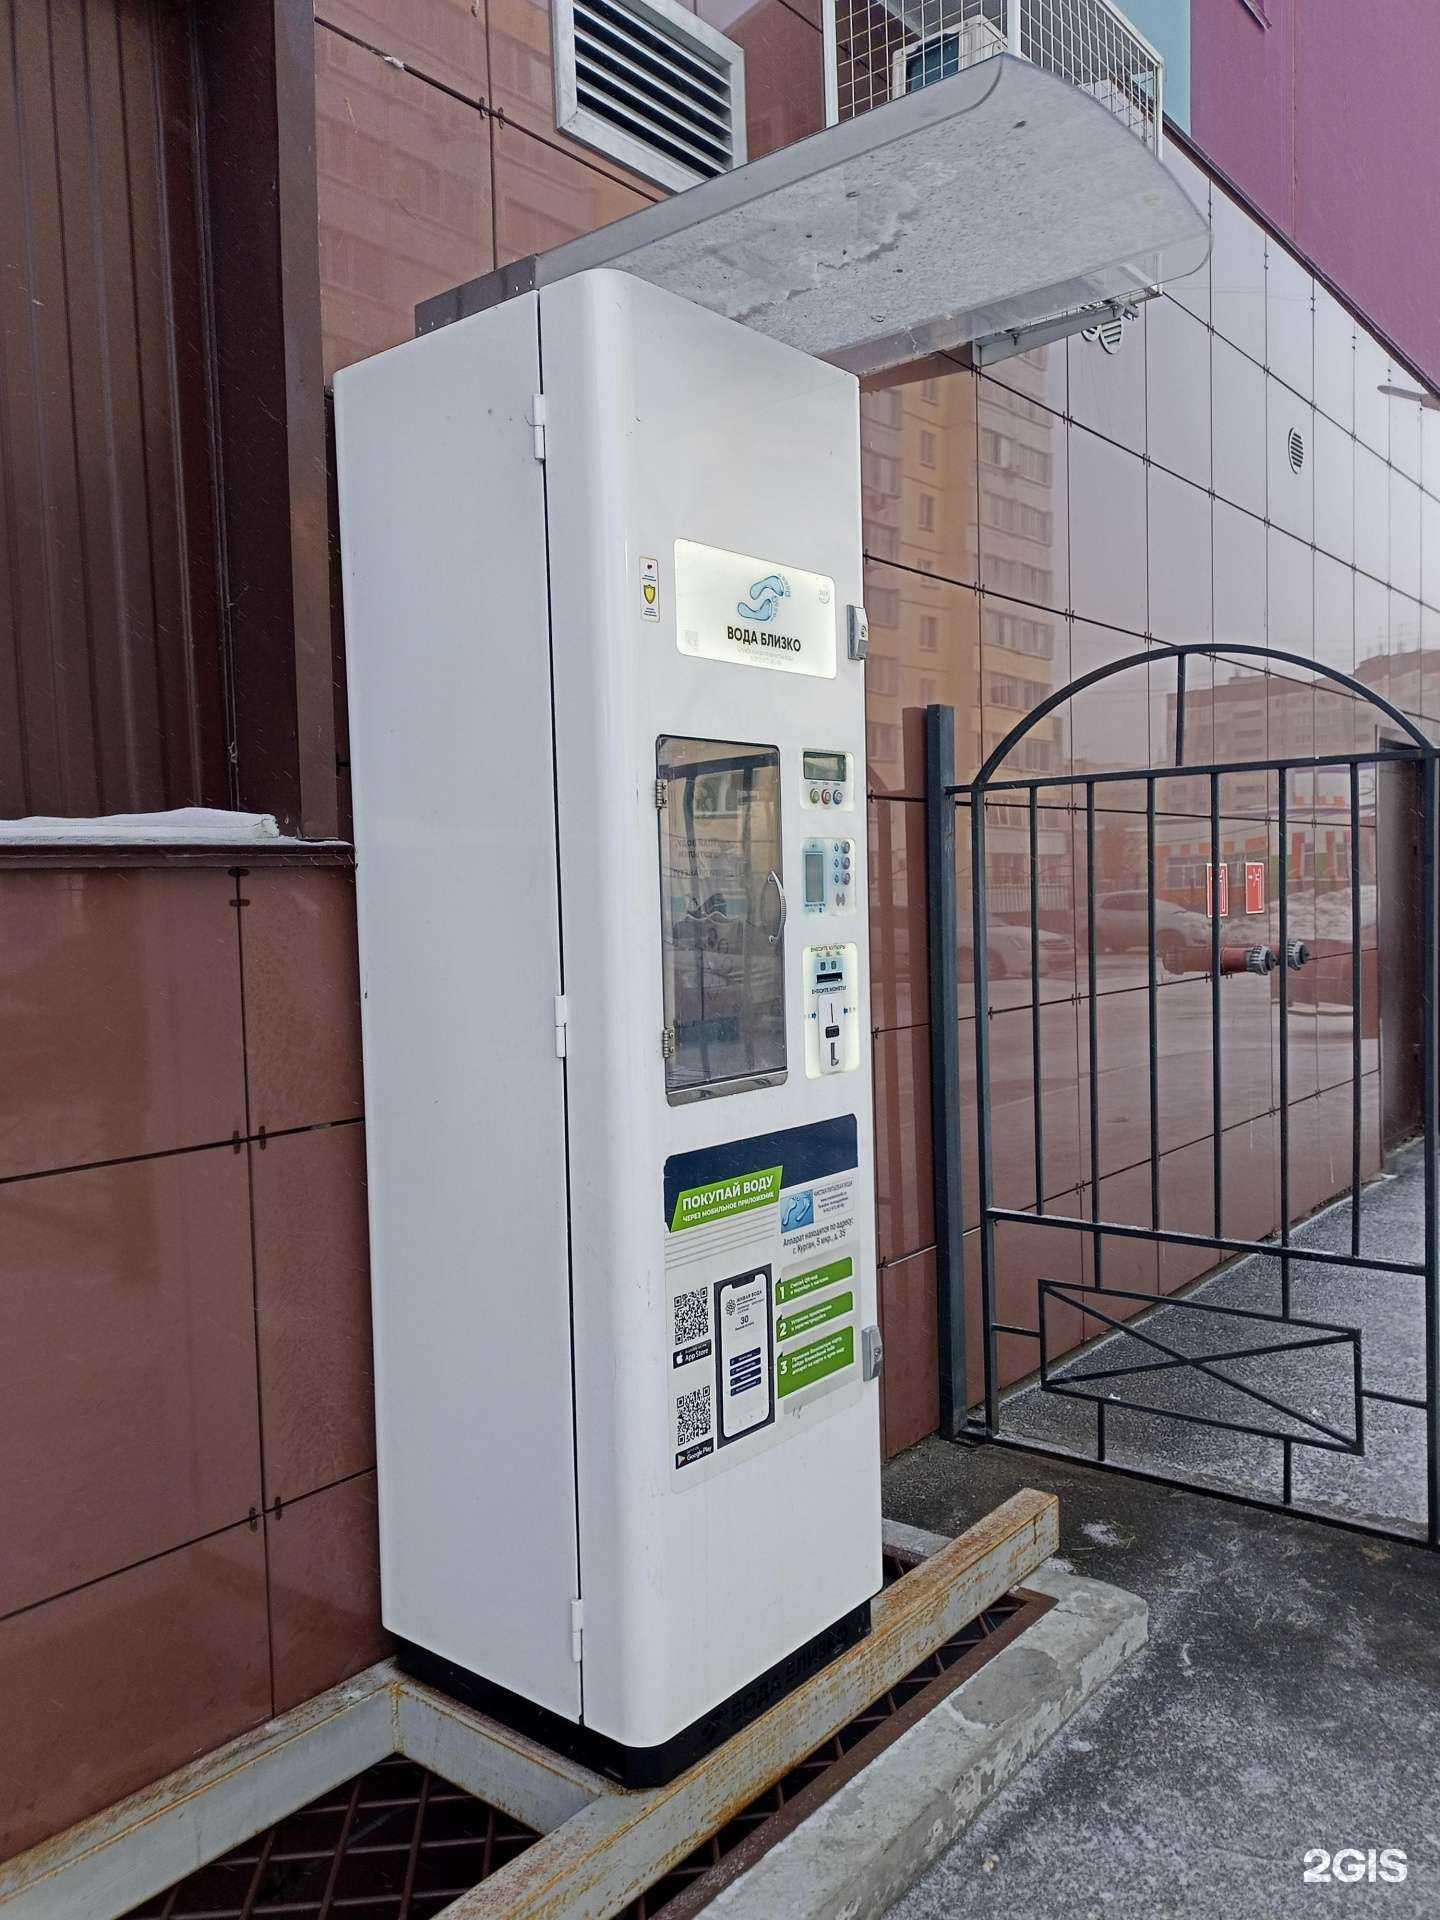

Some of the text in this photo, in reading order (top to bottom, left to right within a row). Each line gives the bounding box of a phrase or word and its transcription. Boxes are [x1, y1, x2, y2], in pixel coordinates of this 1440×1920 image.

[727, 626, 802, 652] ВОДА БЛИЗКО
[682, 1175, 774, 1211] ПОКУПАЙ ВОДУ
[682, 1192, 775, 1222] ЧЕРЕЗ МОБИЛЬНОЕ ПРИЛОЖЕНИЕ
[779, 1286, 785, 1300] 1
[779, 1322, 787, 1337] 2
[695, 1349, 709, 1358] Store
[780, 1360, 788, 1375] 3
